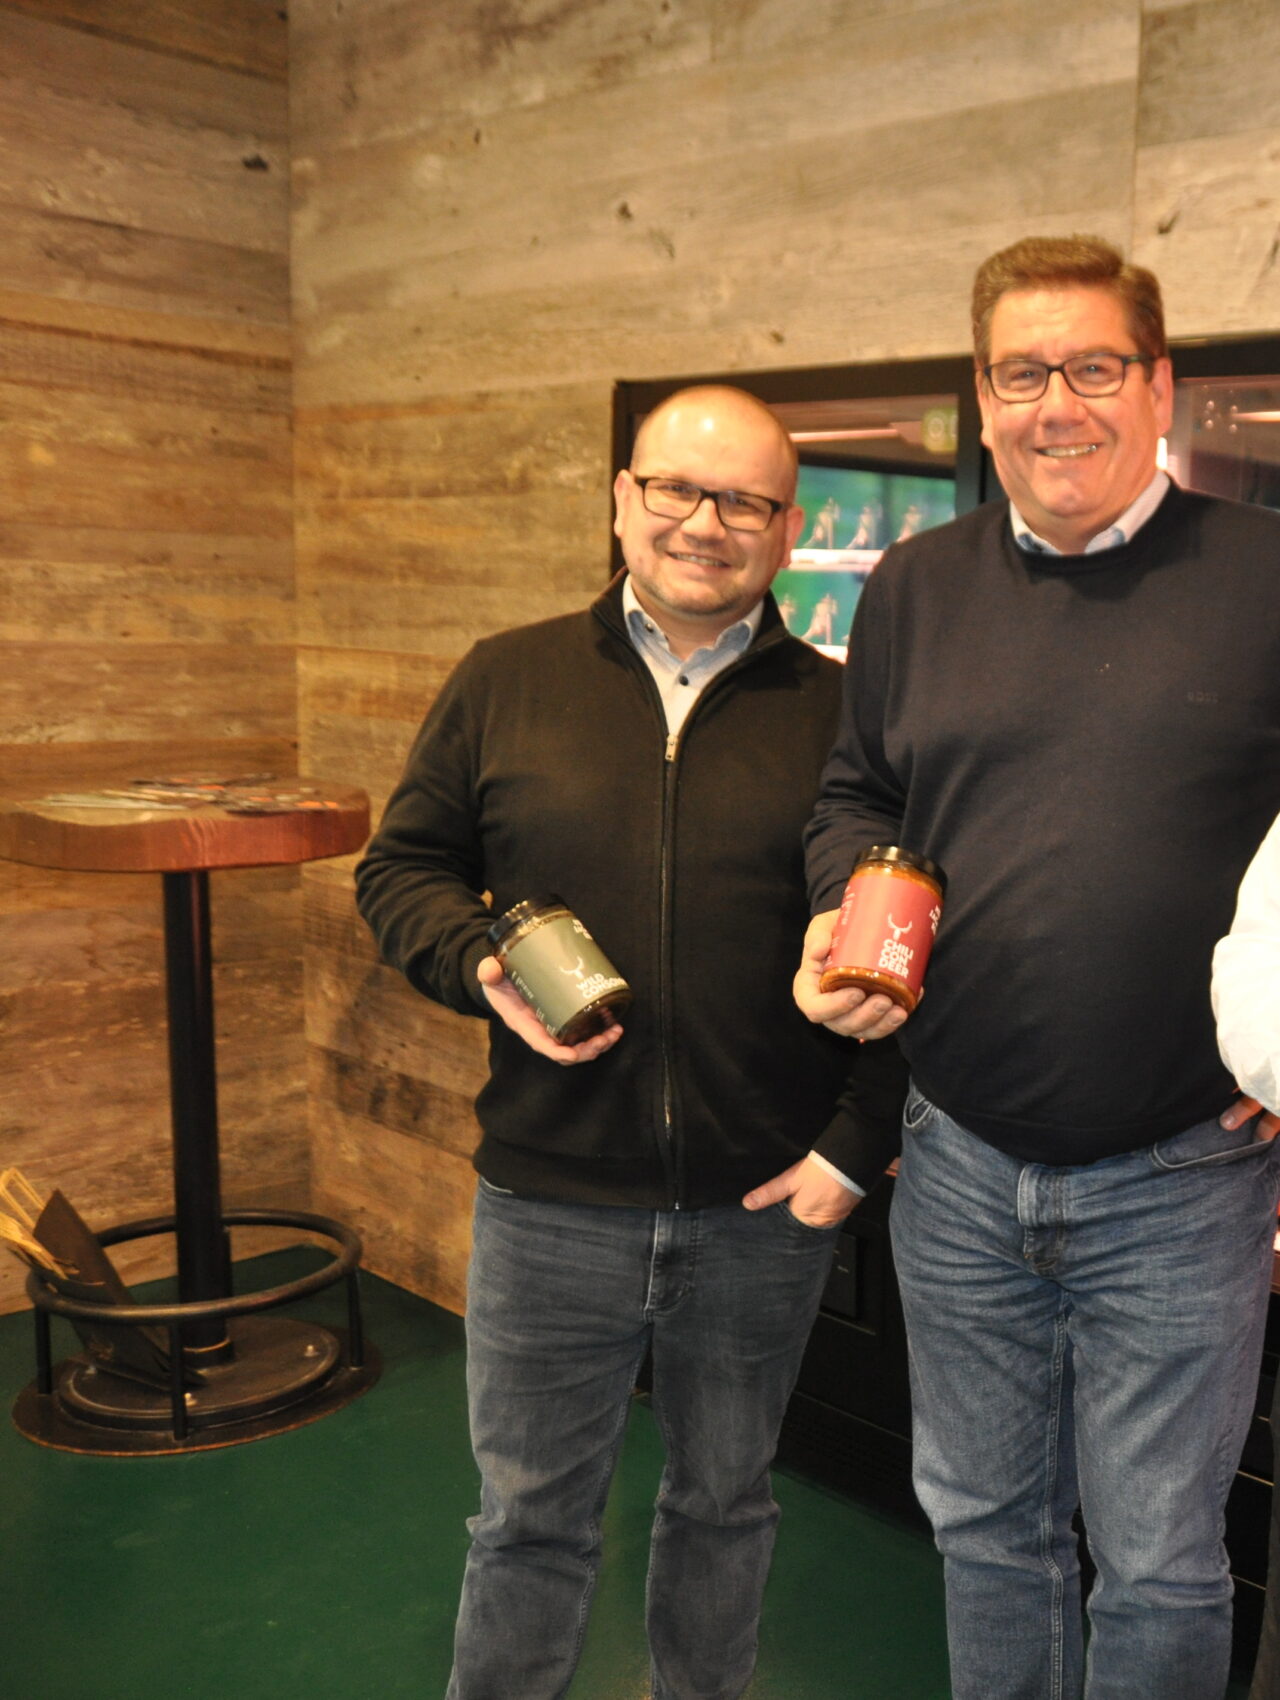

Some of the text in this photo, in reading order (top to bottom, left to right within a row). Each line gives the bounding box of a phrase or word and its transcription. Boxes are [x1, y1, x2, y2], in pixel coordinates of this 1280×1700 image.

[881, 948, 908, 966] CON
[883, 939, 914, 959] CHILI
[878, 958, 909, 979] DEER
